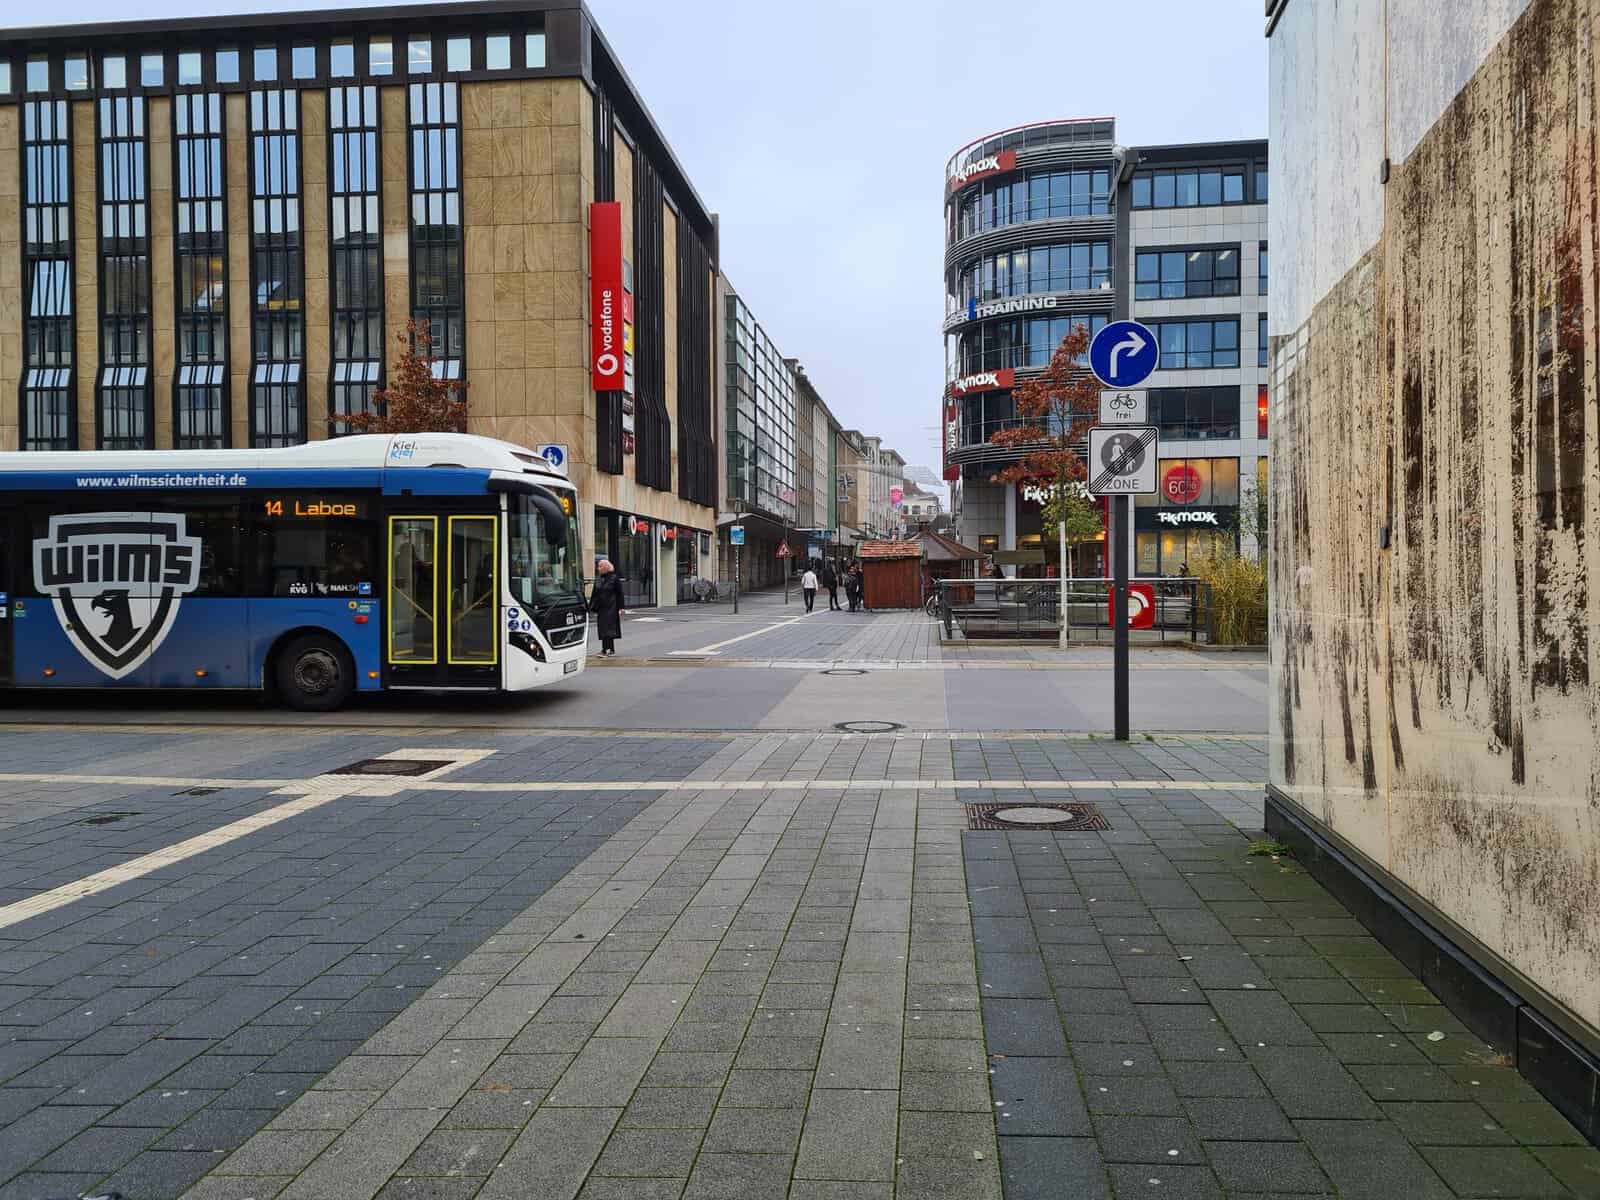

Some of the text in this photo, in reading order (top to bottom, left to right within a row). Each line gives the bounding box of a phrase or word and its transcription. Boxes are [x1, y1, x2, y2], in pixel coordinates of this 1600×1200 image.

[976, 297, 1057, 318] TRAINING
[602, 290, 612, 351] vodafone
[1116, 411, 1131, 419] frei
[77, 473, 247, 488] www.wilmssicherheit.de
[1106, 479, 1139, 490] ZONE
[264, 501, 357, 516] 14 Laboe
